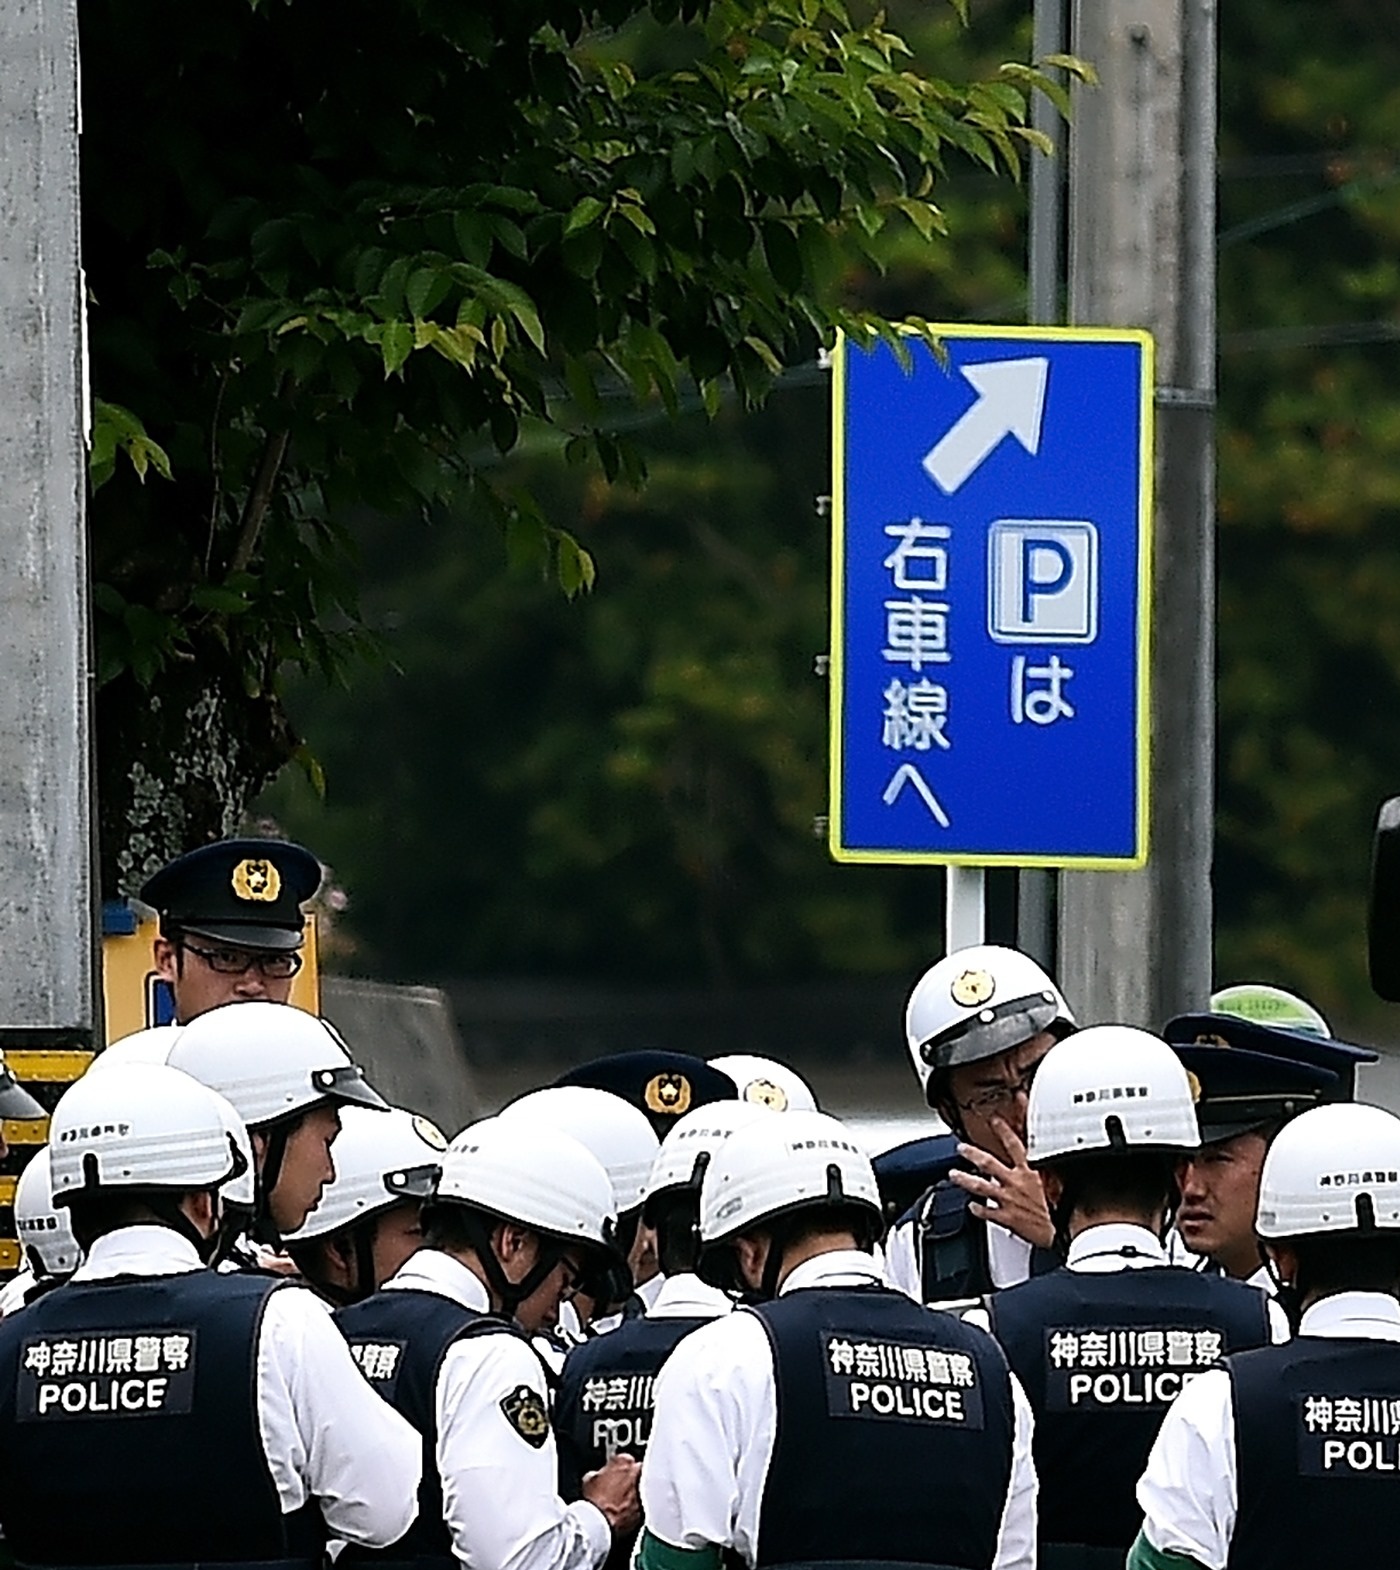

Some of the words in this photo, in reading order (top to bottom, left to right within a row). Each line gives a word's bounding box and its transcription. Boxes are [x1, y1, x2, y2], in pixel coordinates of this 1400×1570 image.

[881, 517, 952, 829] 右車線へ
[24, 1335, 190, 1377] 神奈川県警察
[828, 1338, 974, 1387] 神奈川県警察
[1050, 1330, 1221, 1368] 神奈川県警察
[38, 1378, 168, 1414] POLICE
[582, 1375, 657, 1411] 神奈川
[850, 1382, 964, 1420] POLICE
[1070, 1372, 1203, 1404] POLIC
[593, 1418, 648, 1448] POL
